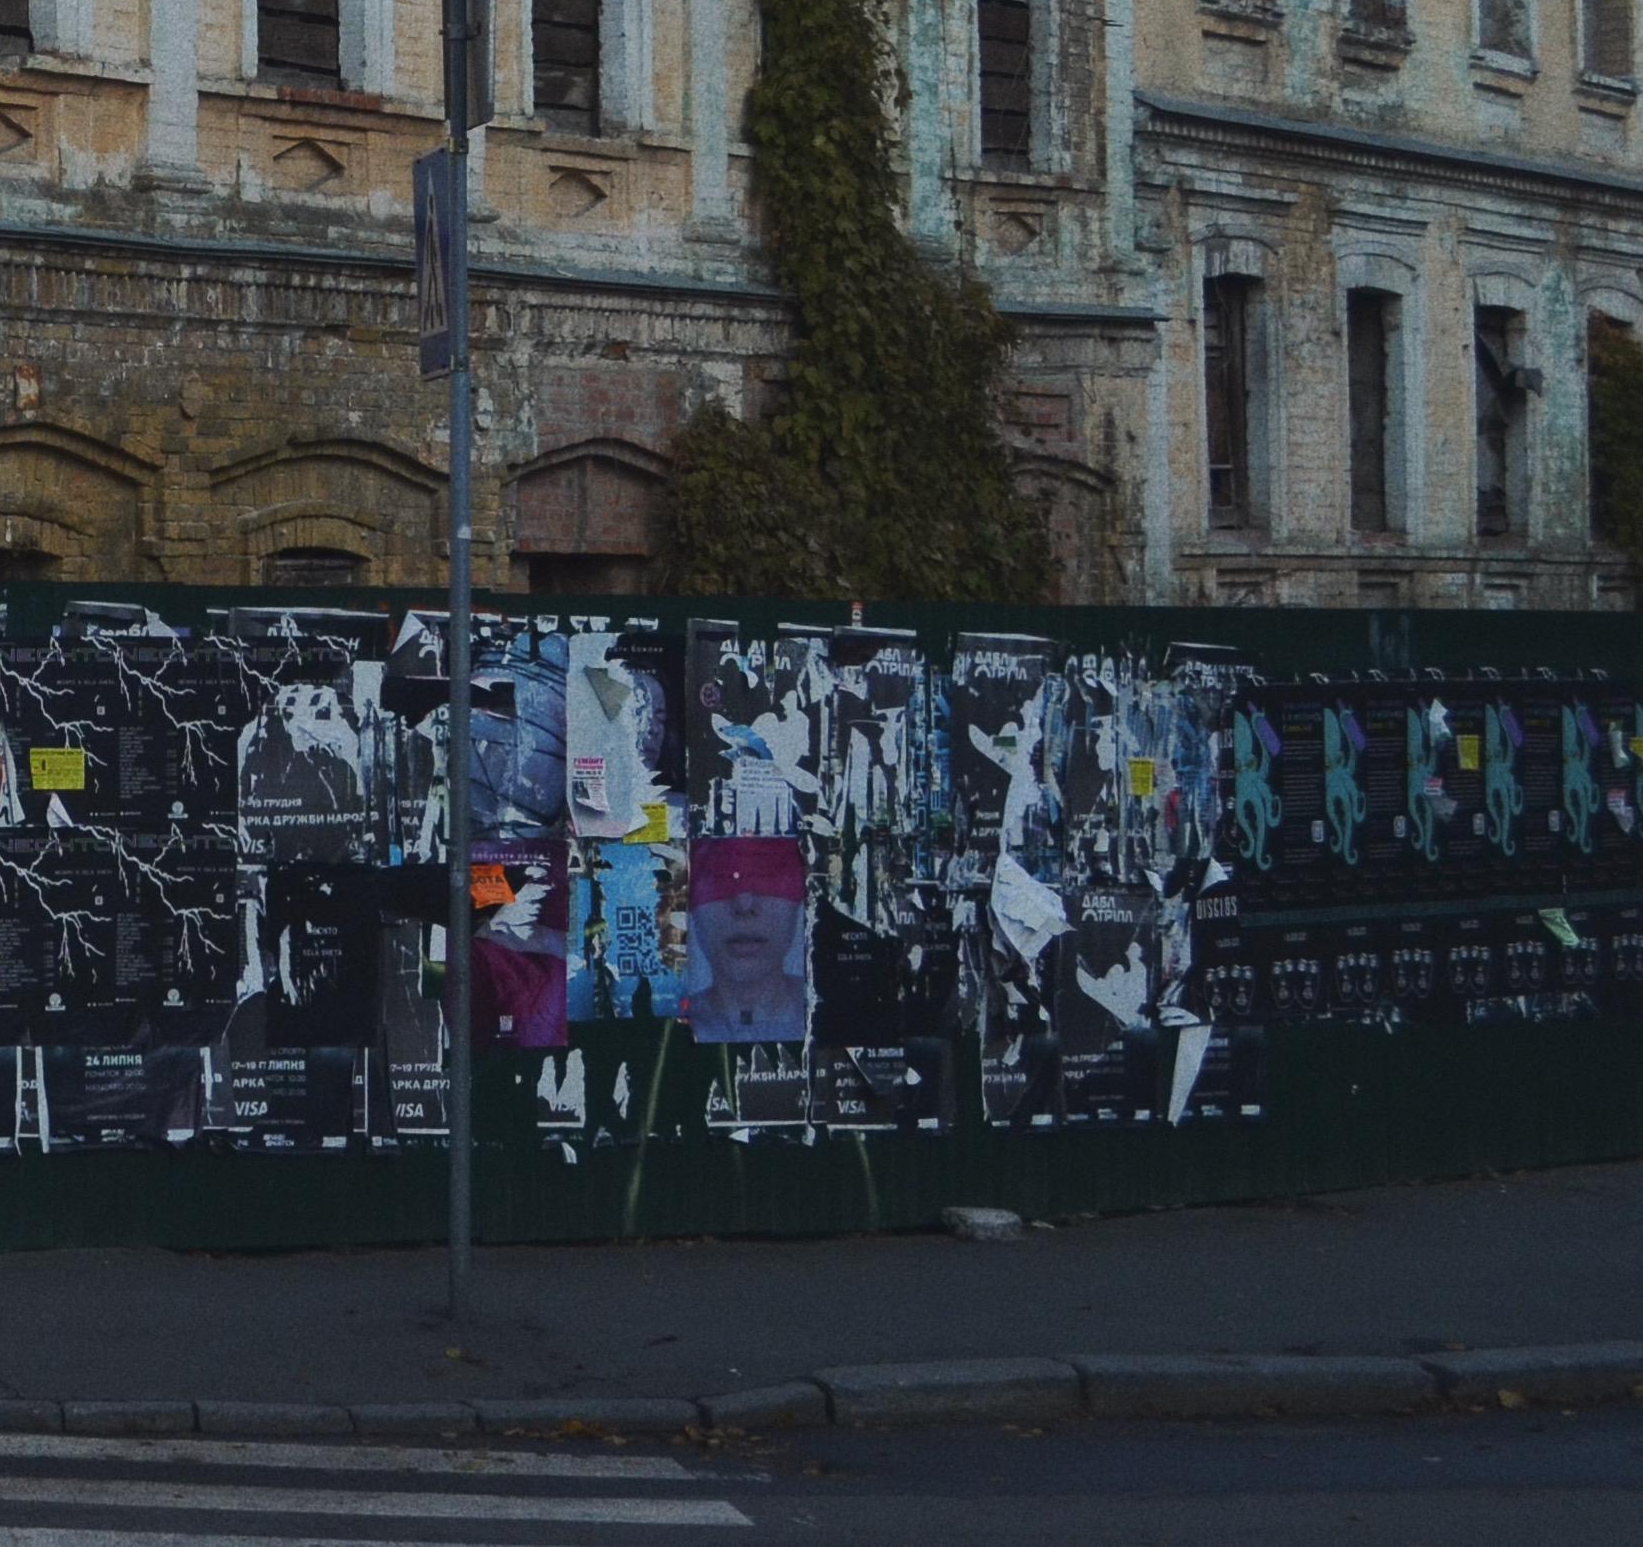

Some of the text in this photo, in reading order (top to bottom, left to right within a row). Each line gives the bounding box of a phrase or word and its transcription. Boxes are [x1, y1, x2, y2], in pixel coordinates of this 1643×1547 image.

[263, 797, 302, 808] ГРУДНЯ
[272, 813, 325, 826] ДРУЖБИ
[241, 839, 267, 853] VIS
[1081, 894, 1116, 908] ДАБЛ
[85, 1054, 142, 1067] 24 ЛИПНЯ
[267, 1060, 305, 1071] ЛИПНЯ
[233, 1077, 265, 1088] АРКА
[234, 1101, 268, 1116] VISA
[836, 1100, 866, 1114] VISA
